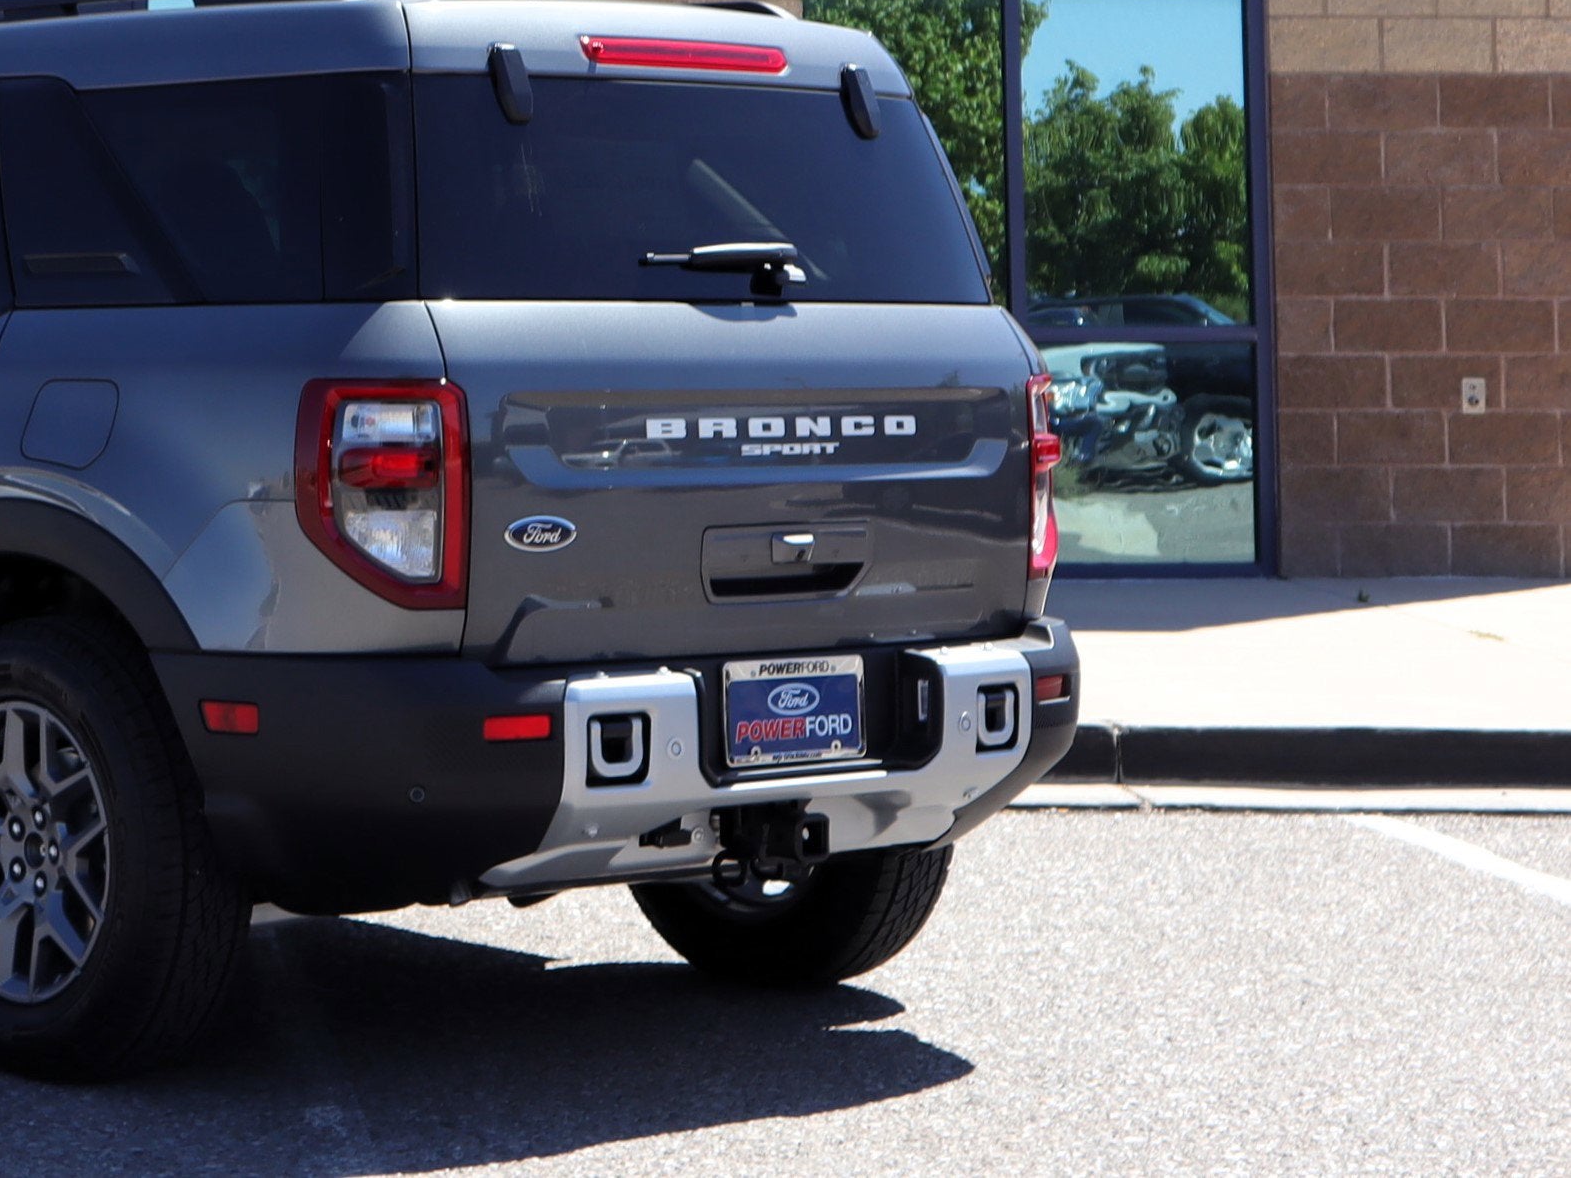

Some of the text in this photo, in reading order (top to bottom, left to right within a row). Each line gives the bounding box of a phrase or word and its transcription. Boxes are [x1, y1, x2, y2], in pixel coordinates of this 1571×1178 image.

[645, 414, 917, 439] BRONCO
[740, 441, 840, 457] SPORT
[522, 522, 562, 544] Ford
[759, 660, 829, 676] POWERFORD
[779, 689, 809, 708] Ford
[736, 714, 852, 743] POWERFORD
